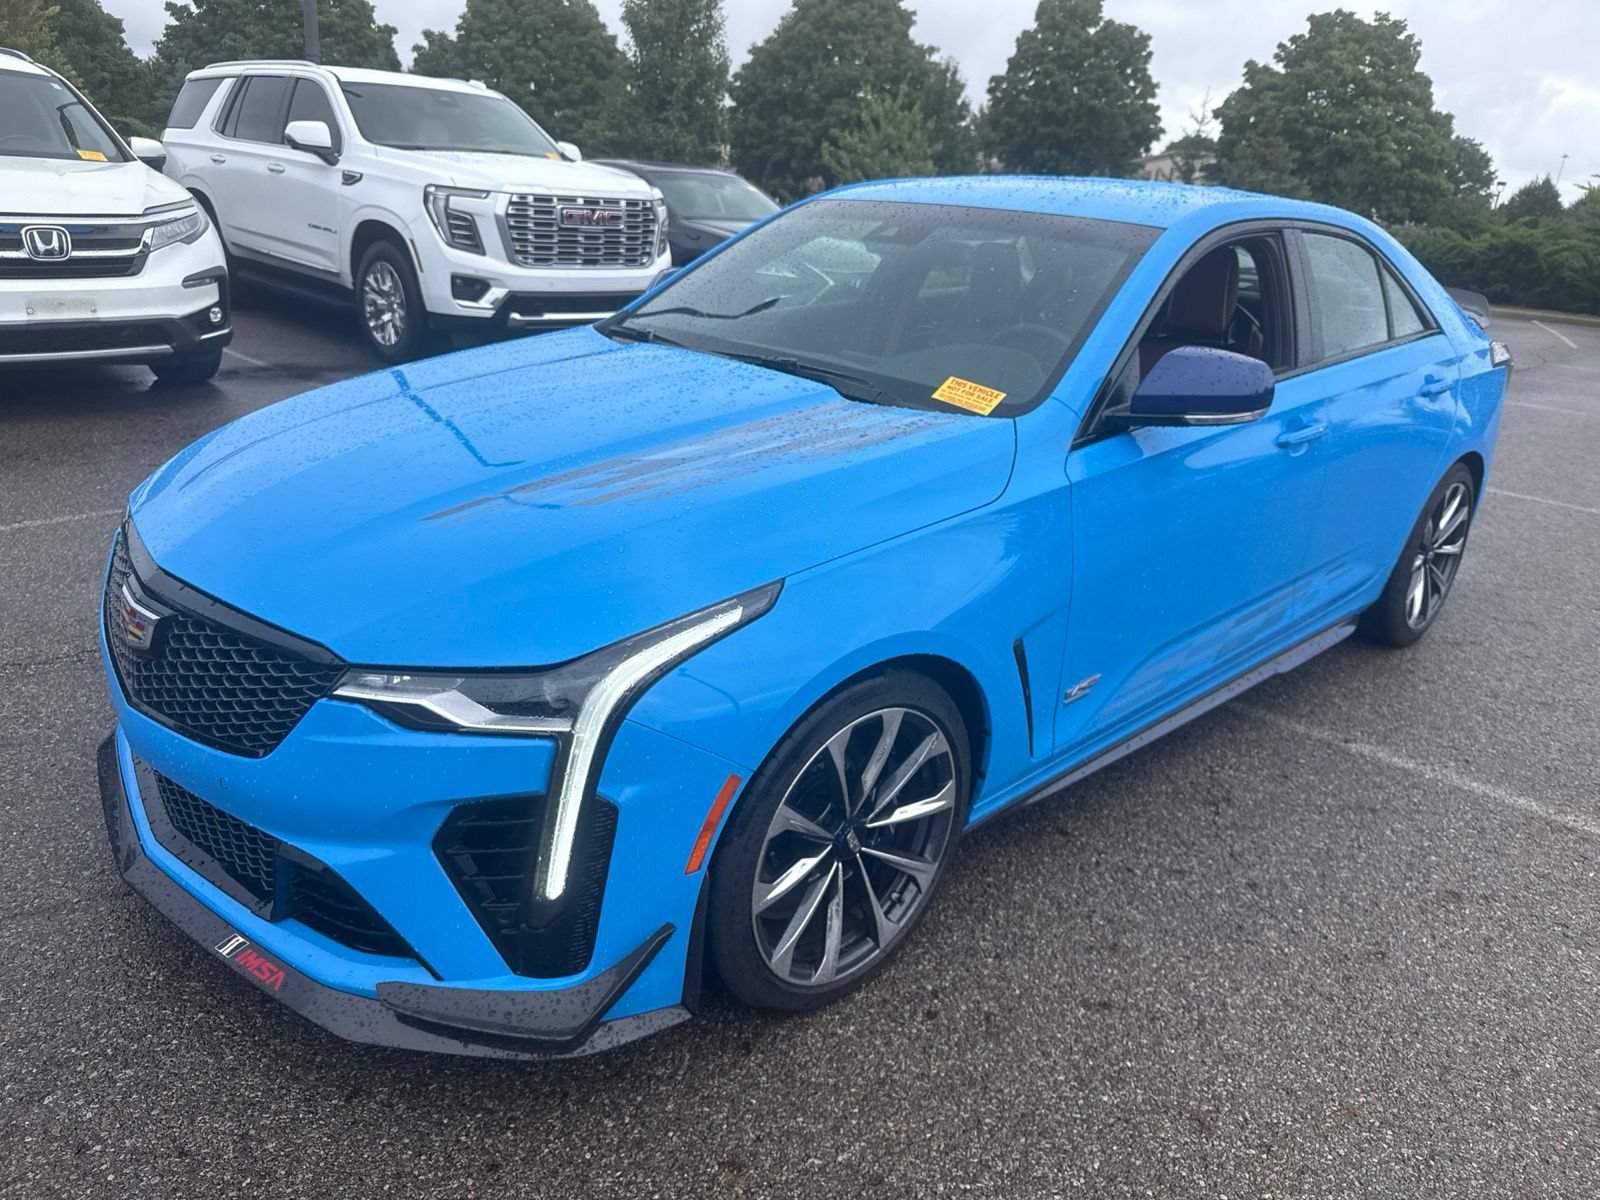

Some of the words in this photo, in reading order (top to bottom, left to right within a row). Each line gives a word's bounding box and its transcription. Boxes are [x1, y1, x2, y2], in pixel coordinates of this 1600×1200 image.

[563, 209, 622, 225] GMC
[950, 379, 970, 389] THIS
[969, 383, 1001, 399] VEHICLE
[961, 389, 975, 397] FOR
[976, 393, 993, 403] SALE
[234, 949, 285, 991] IMSA
